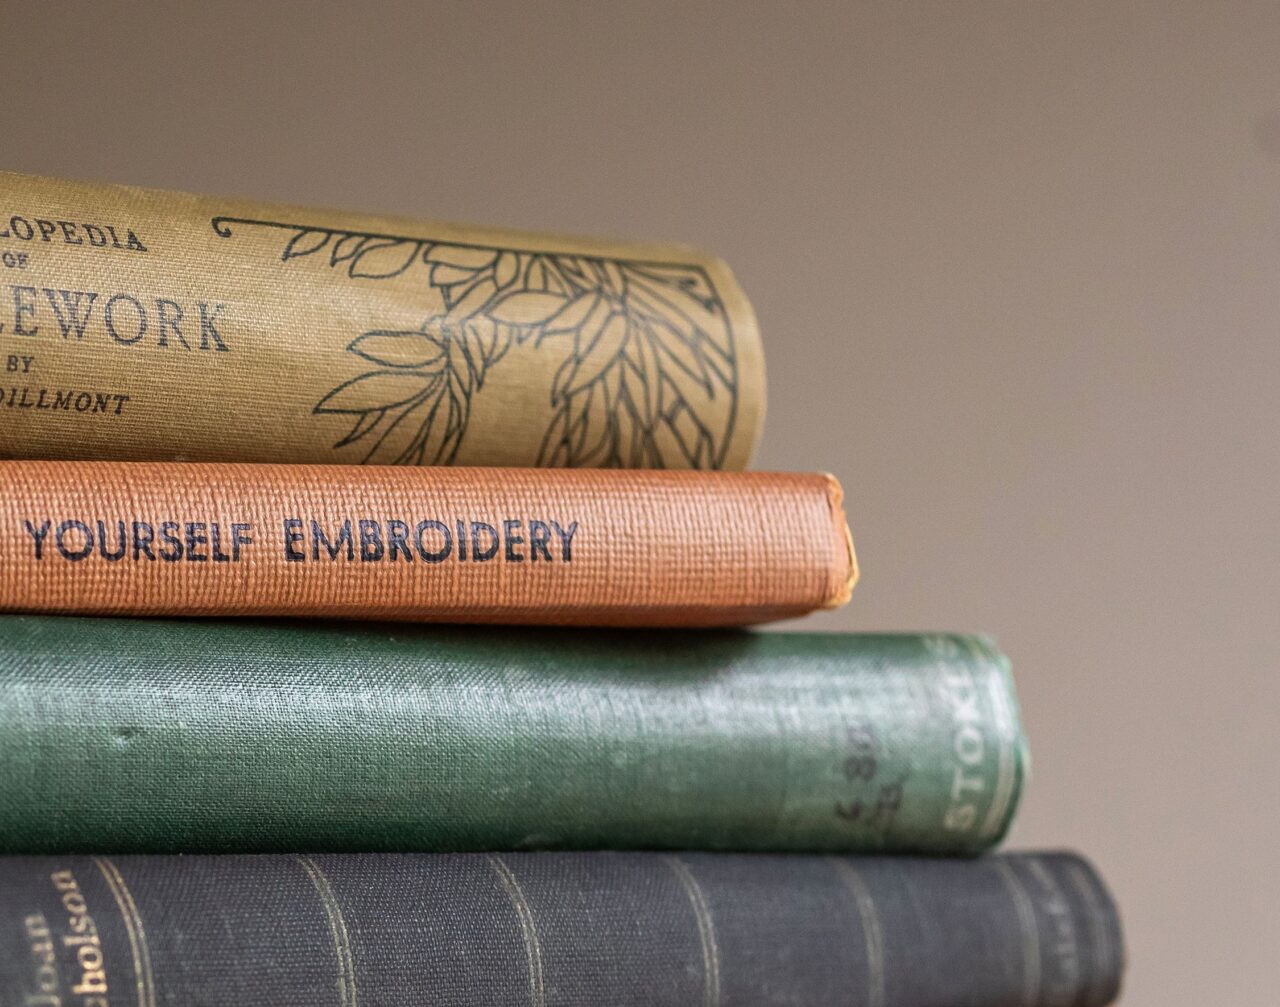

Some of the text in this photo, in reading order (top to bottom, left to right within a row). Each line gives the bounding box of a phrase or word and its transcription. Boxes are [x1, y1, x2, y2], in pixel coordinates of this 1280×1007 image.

[2, 251, 28, 269] OF
[7, 355, 34, 374] BY
[24, 518, 254, 564] YOURSELF
[284, 518, 579, 564] EMBROIDERY
